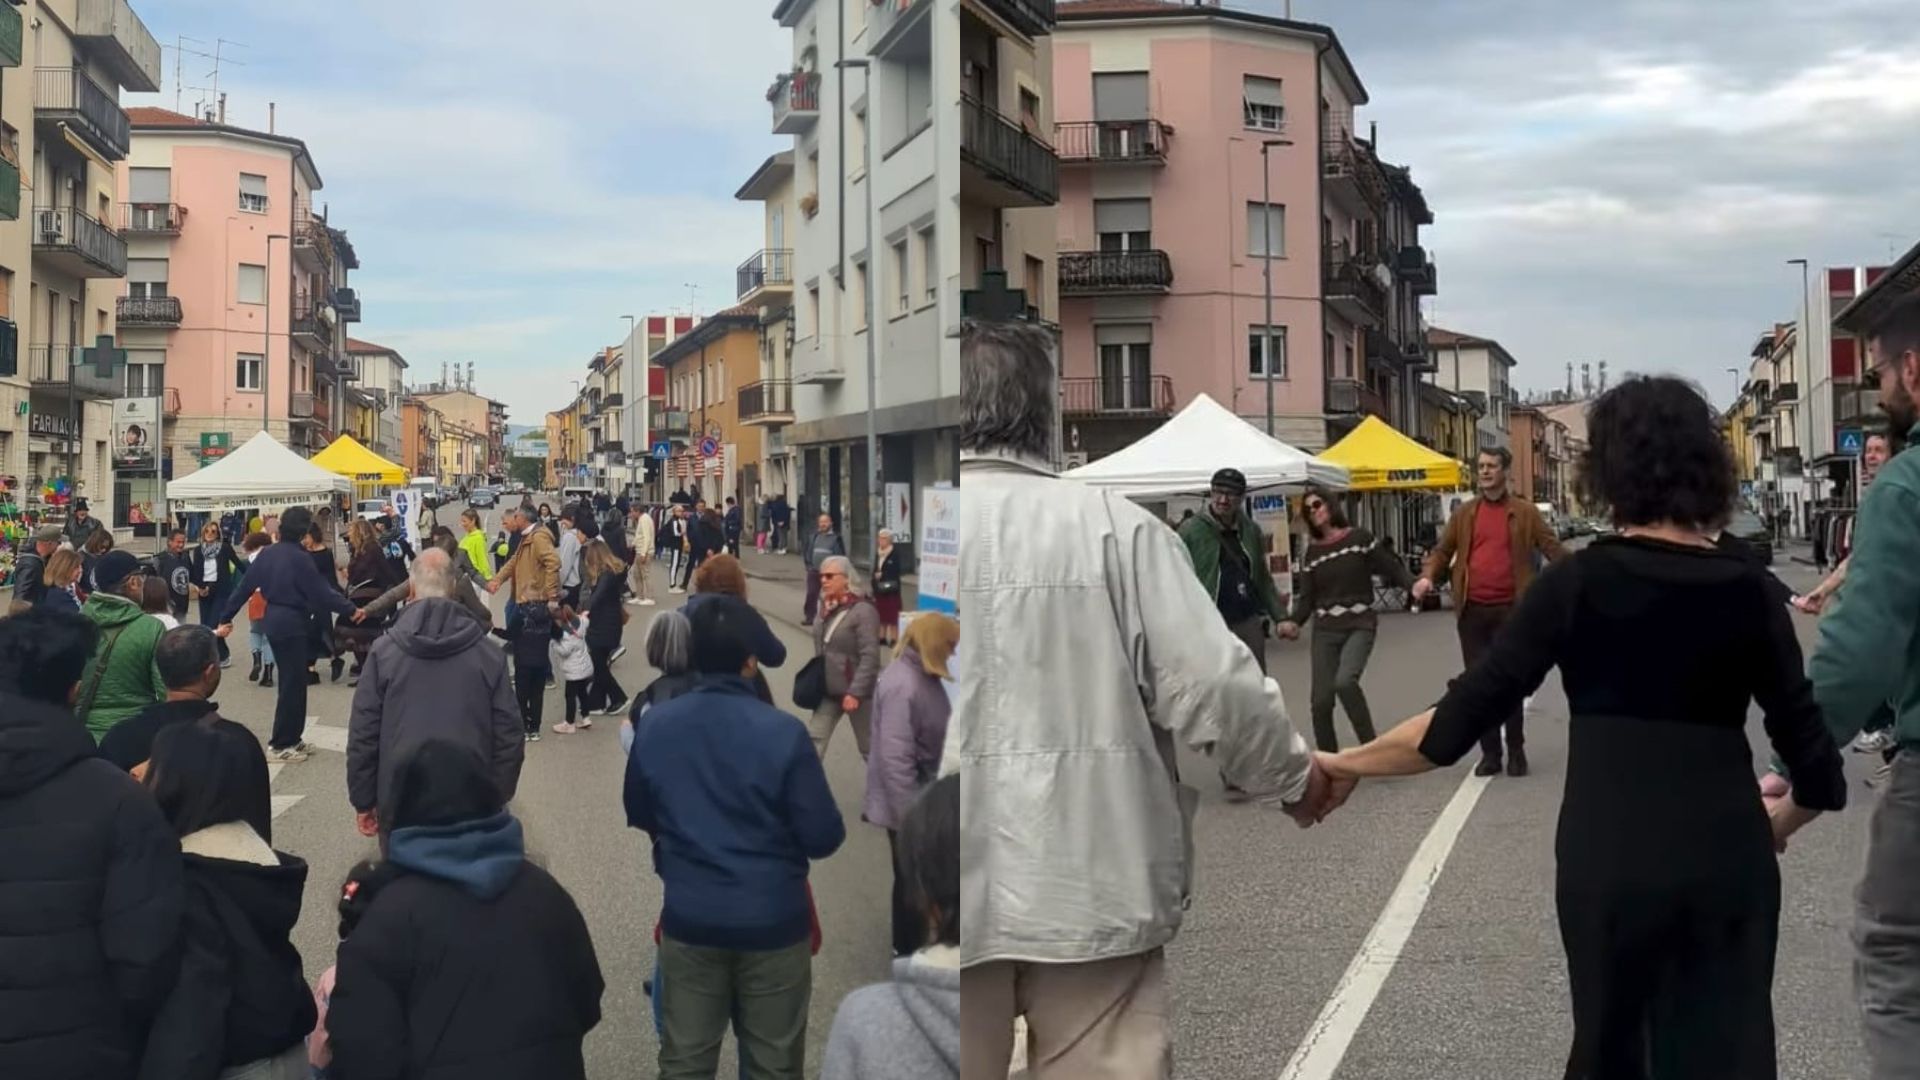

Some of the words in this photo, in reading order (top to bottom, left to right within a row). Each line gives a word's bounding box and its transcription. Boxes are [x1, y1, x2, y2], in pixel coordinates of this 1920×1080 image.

[32, 413, 79, 436] FARMACA
[1387, 468, 1427, 481] AVIS
[224, 498, 258, 508] CONTRO
[262, 495, 311, 505] L'EPILESSIA
[1253, 494, 1284, 509] AVIS
